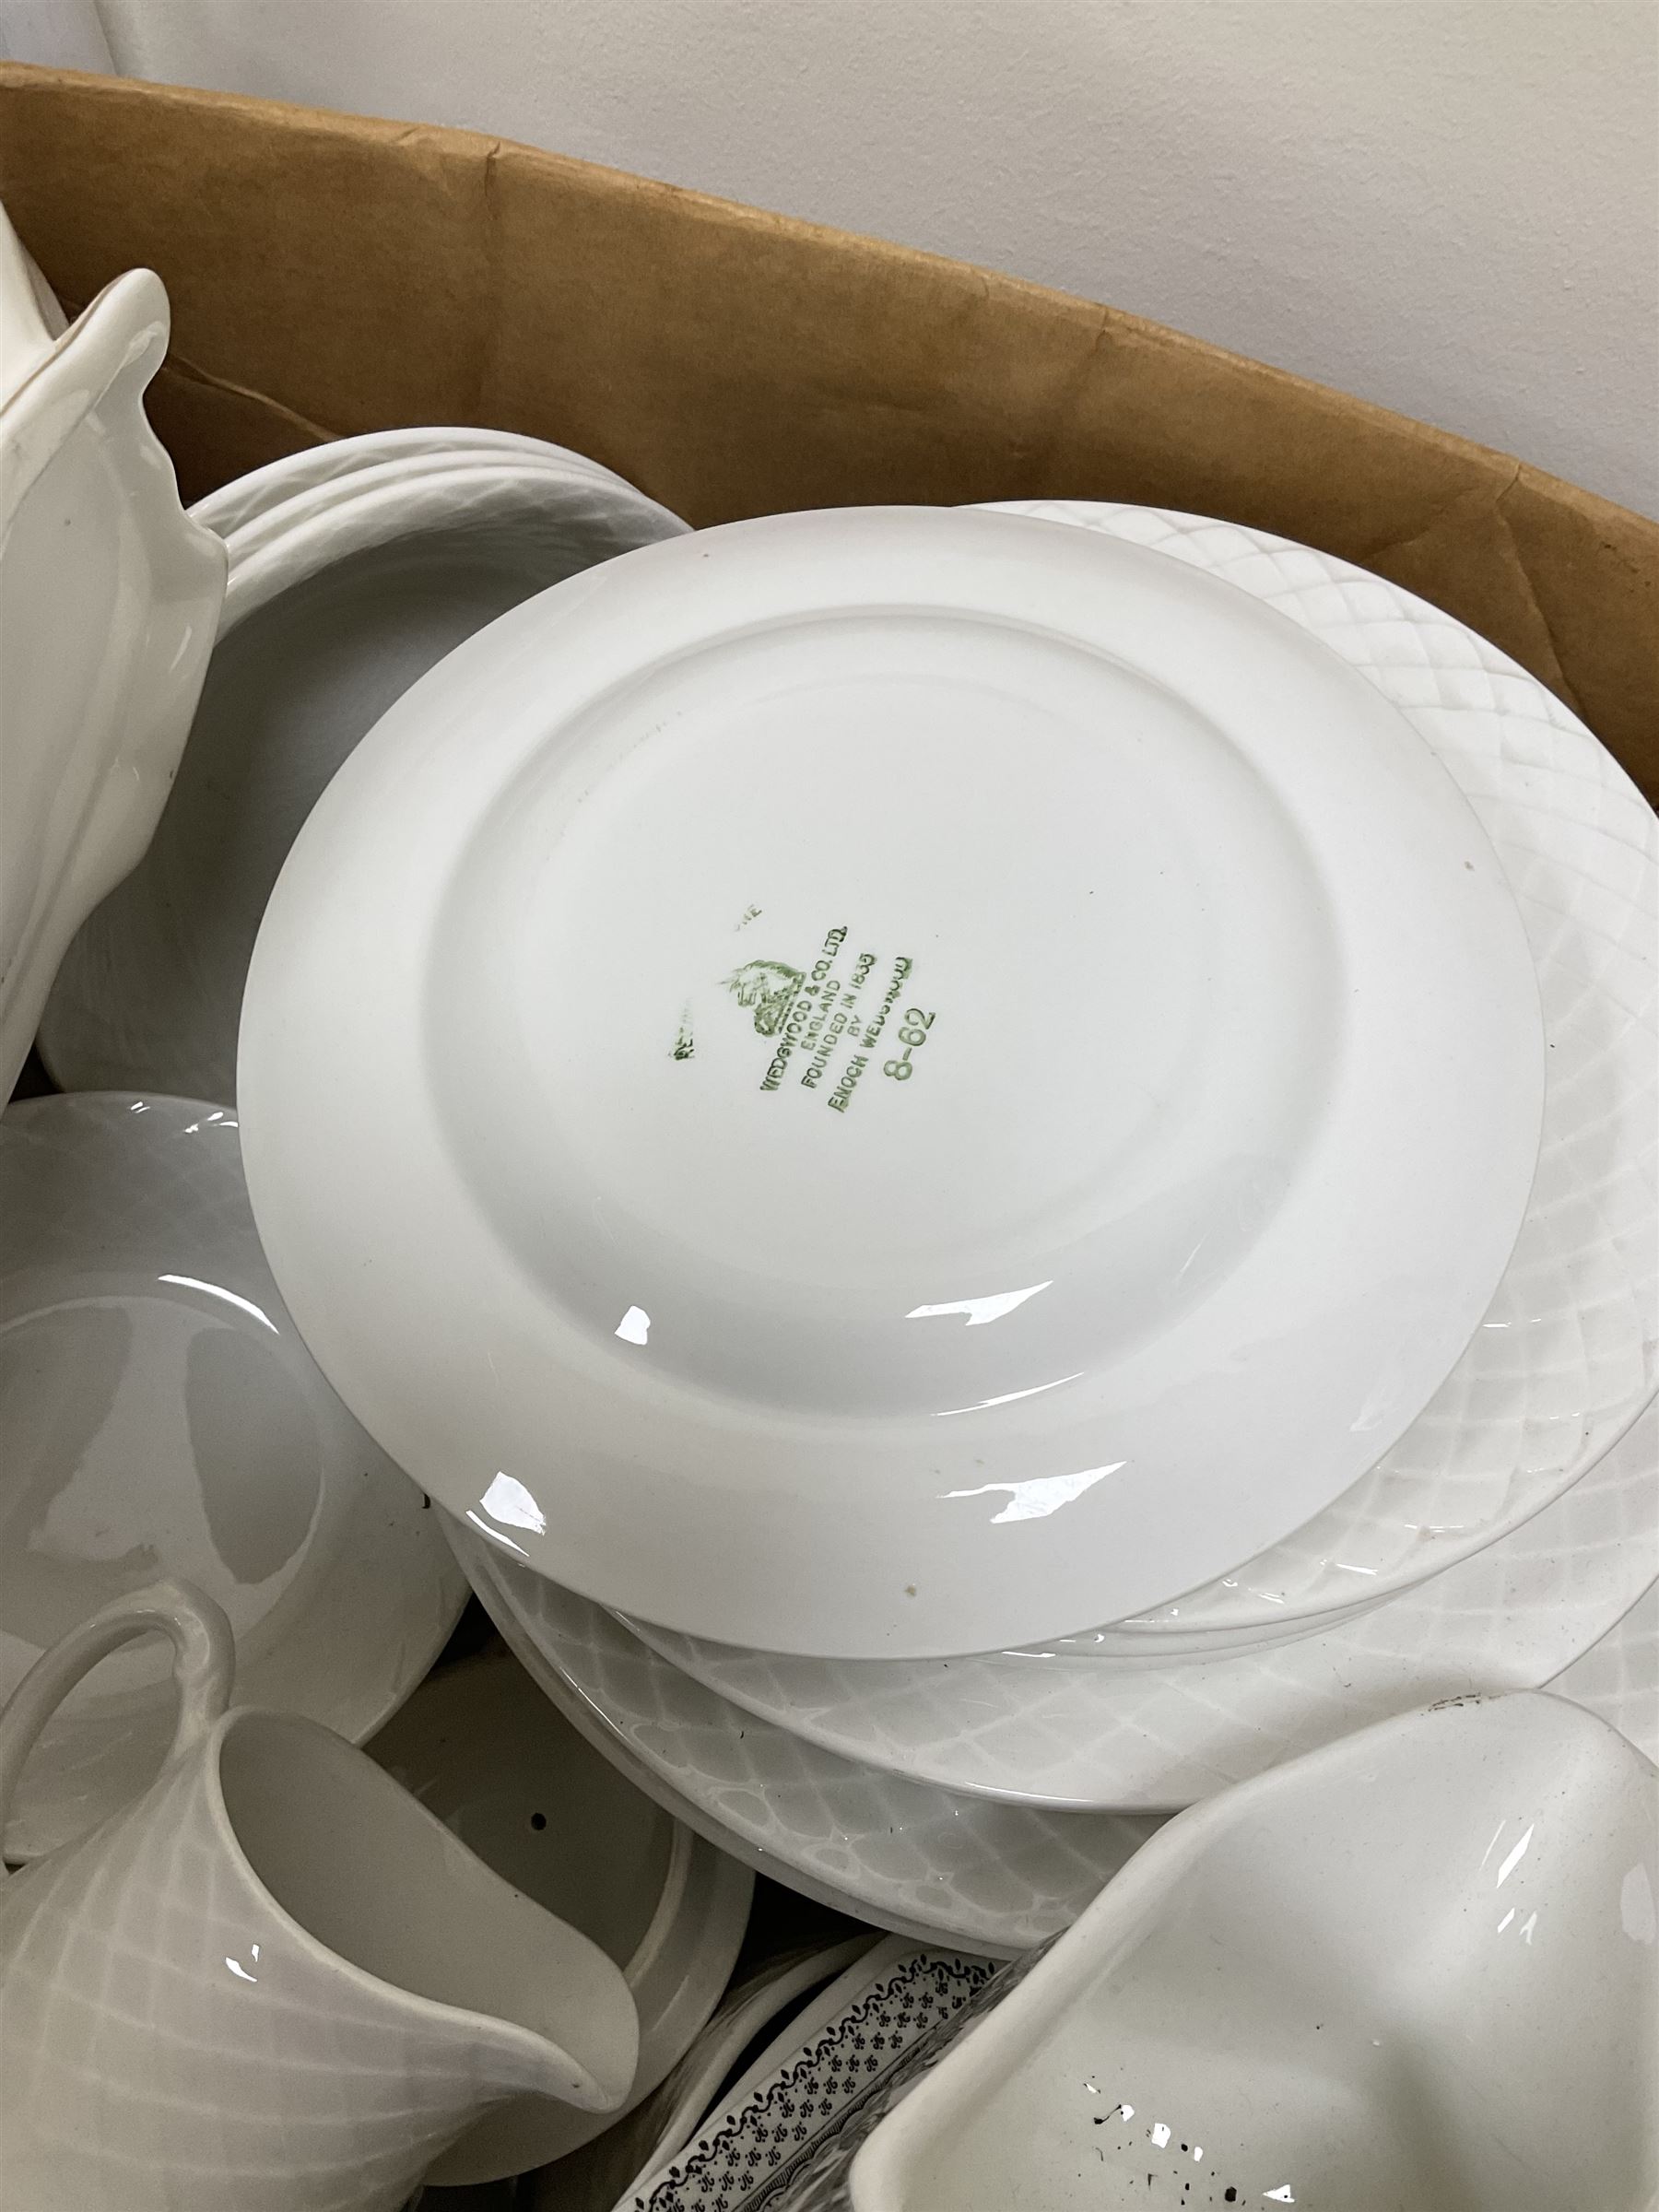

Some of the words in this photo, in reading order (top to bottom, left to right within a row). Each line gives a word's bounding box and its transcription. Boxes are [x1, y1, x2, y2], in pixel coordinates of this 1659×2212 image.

[805, 983, 820, 996] &
[811, 959, 833, 982] CO.
[759, 999, 813, 1091] WEDGWOOD
[801, 979, 841, 1051] ENGLAND
[801, 1012, 848, 1088] FOUNDED
[841, 993, 857, 1009] IN
[849, 953, 876, 990] 1835
[847, 1014, 864, 1038] BY
[883, 1007, 936, 1081] 8-62
[828, 1054, 869, 1112] ENOCH
